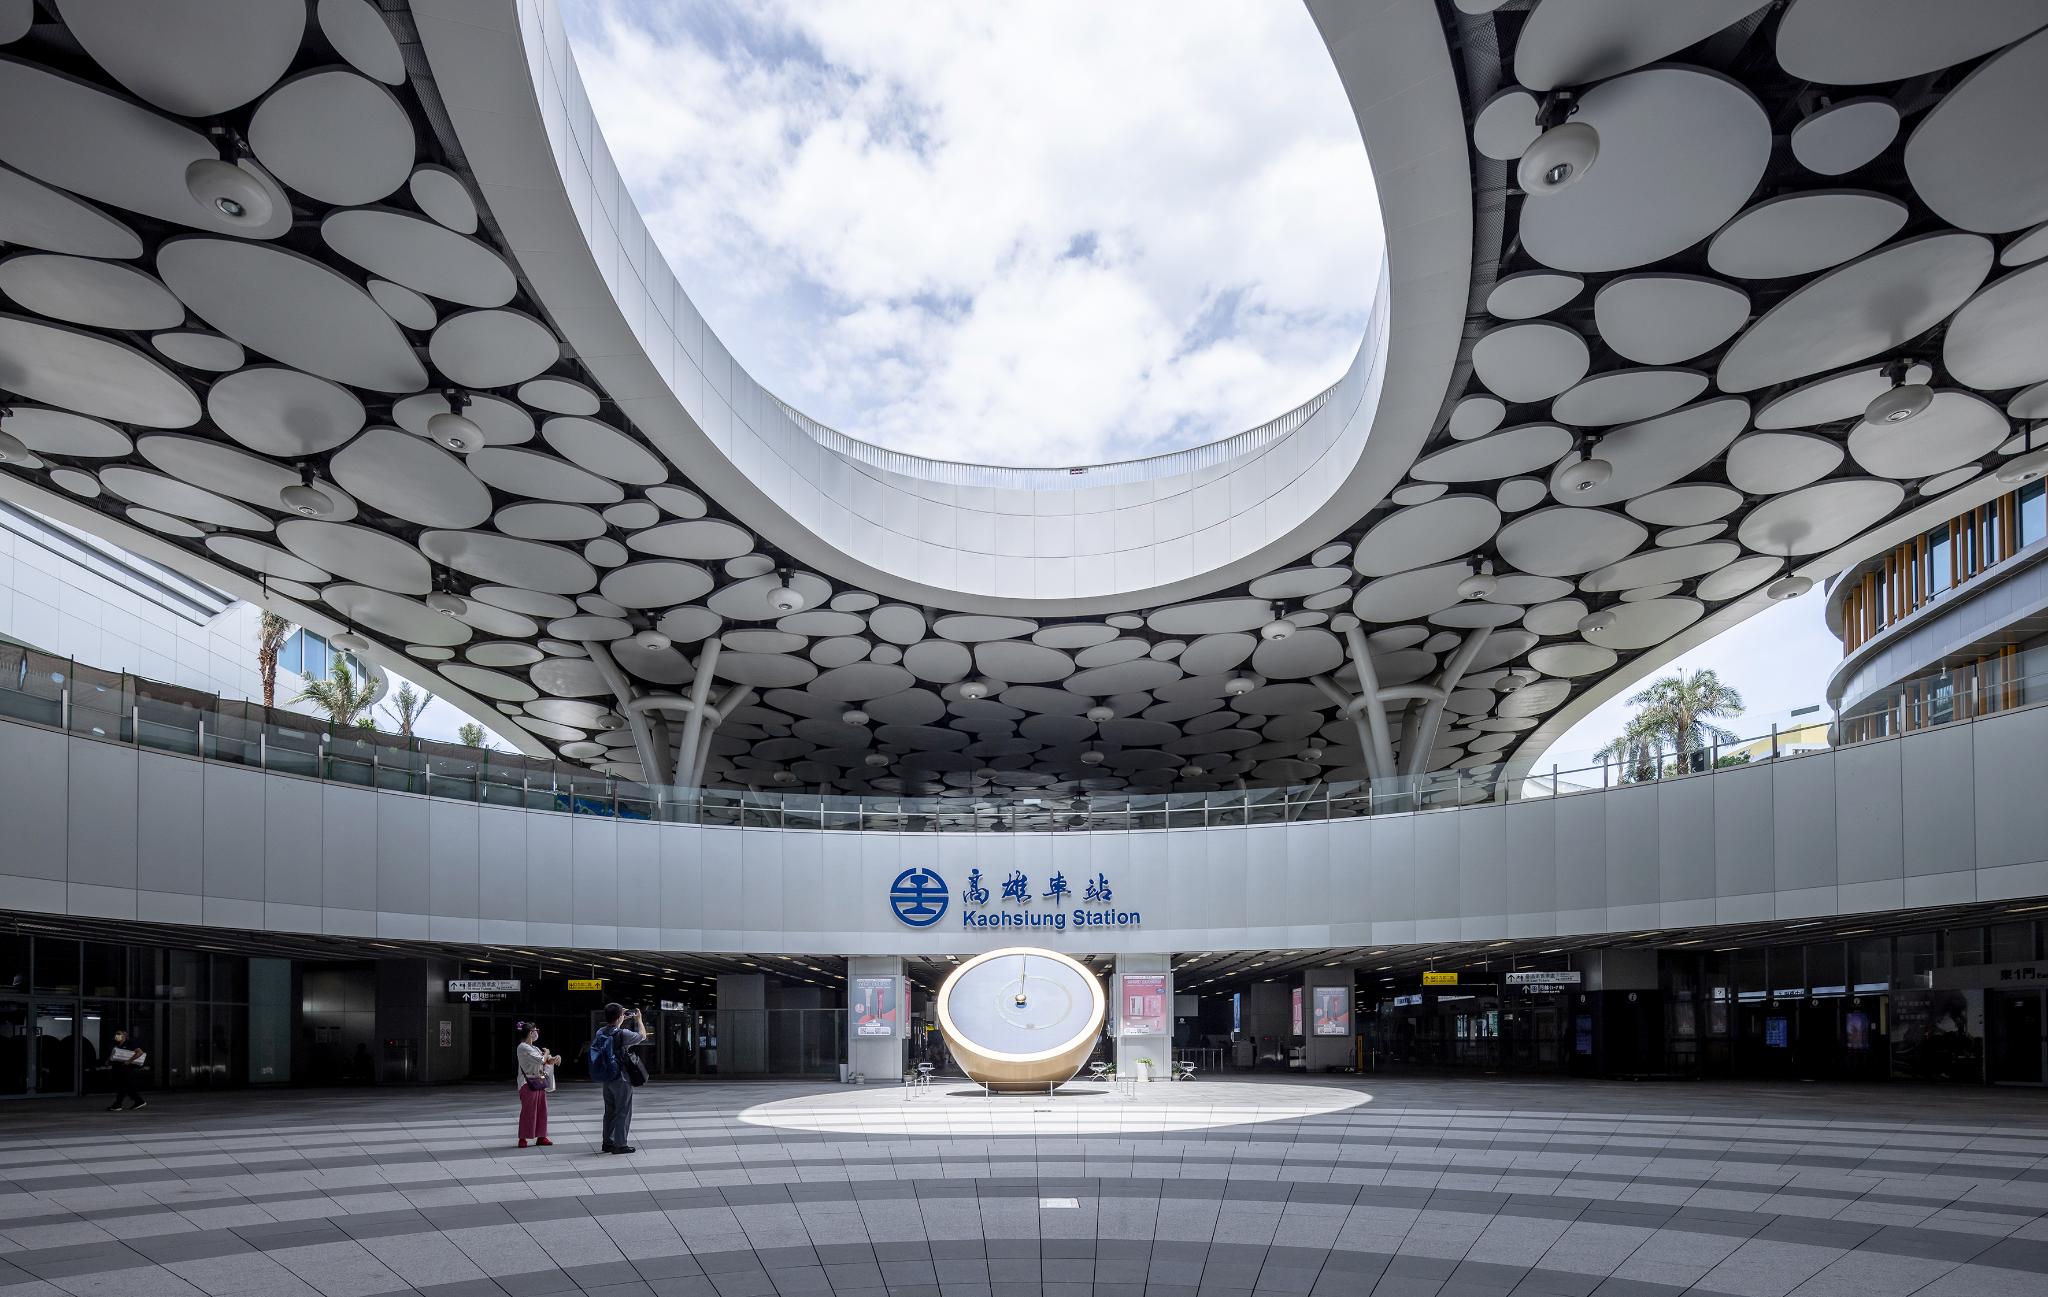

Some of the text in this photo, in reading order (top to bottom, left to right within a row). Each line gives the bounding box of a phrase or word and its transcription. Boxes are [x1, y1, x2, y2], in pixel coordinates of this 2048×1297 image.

[962, 868, 1113, 905] 高雄車站
[963, 908, 1141, 929] Kaohsiung Station
